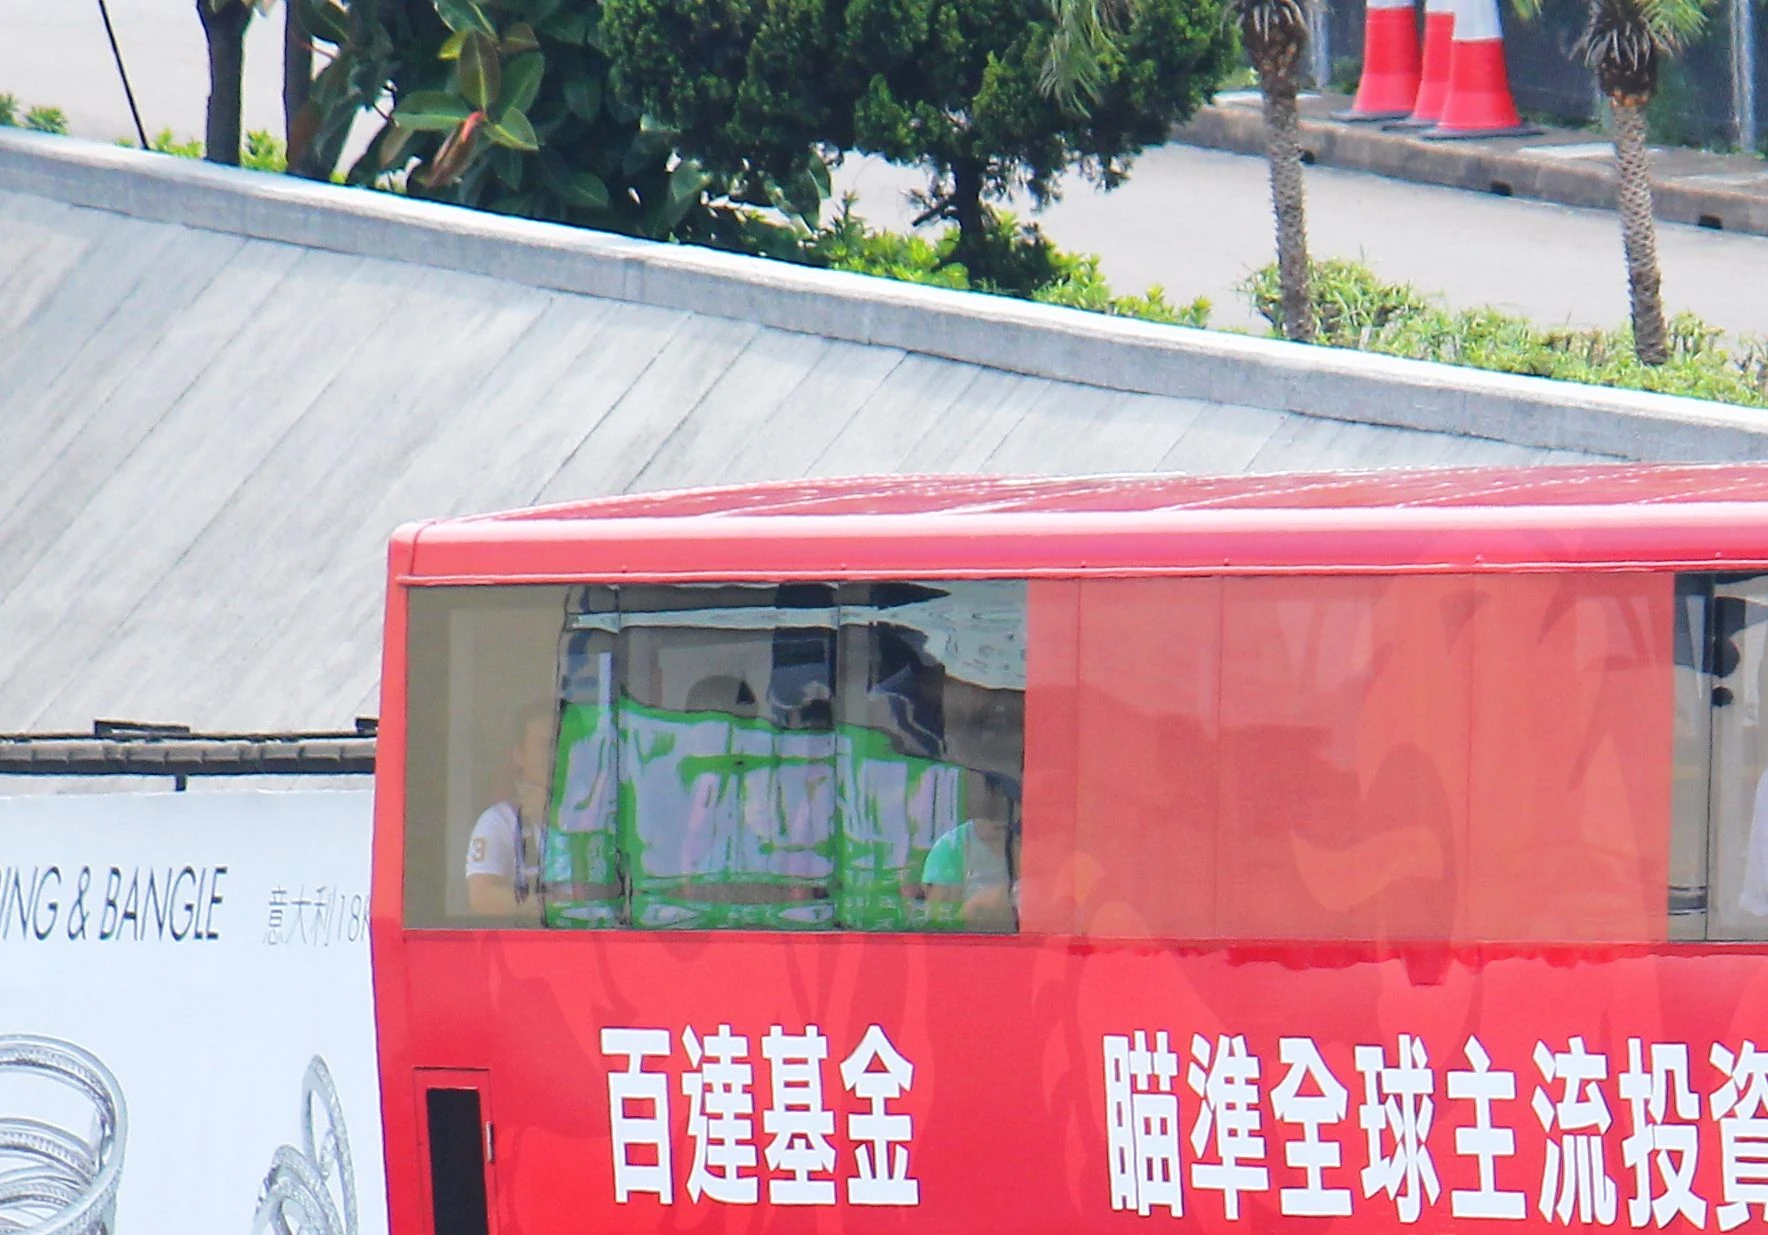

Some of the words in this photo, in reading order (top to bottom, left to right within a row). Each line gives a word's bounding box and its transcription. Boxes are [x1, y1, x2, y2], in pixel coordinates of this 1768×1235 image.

[0, 866, 62, 941] ING
[67, 866, 91, 941] &
[98, 866, 228, 942] BANGLE
[600, 1023, 921, 1206] 百達基金
